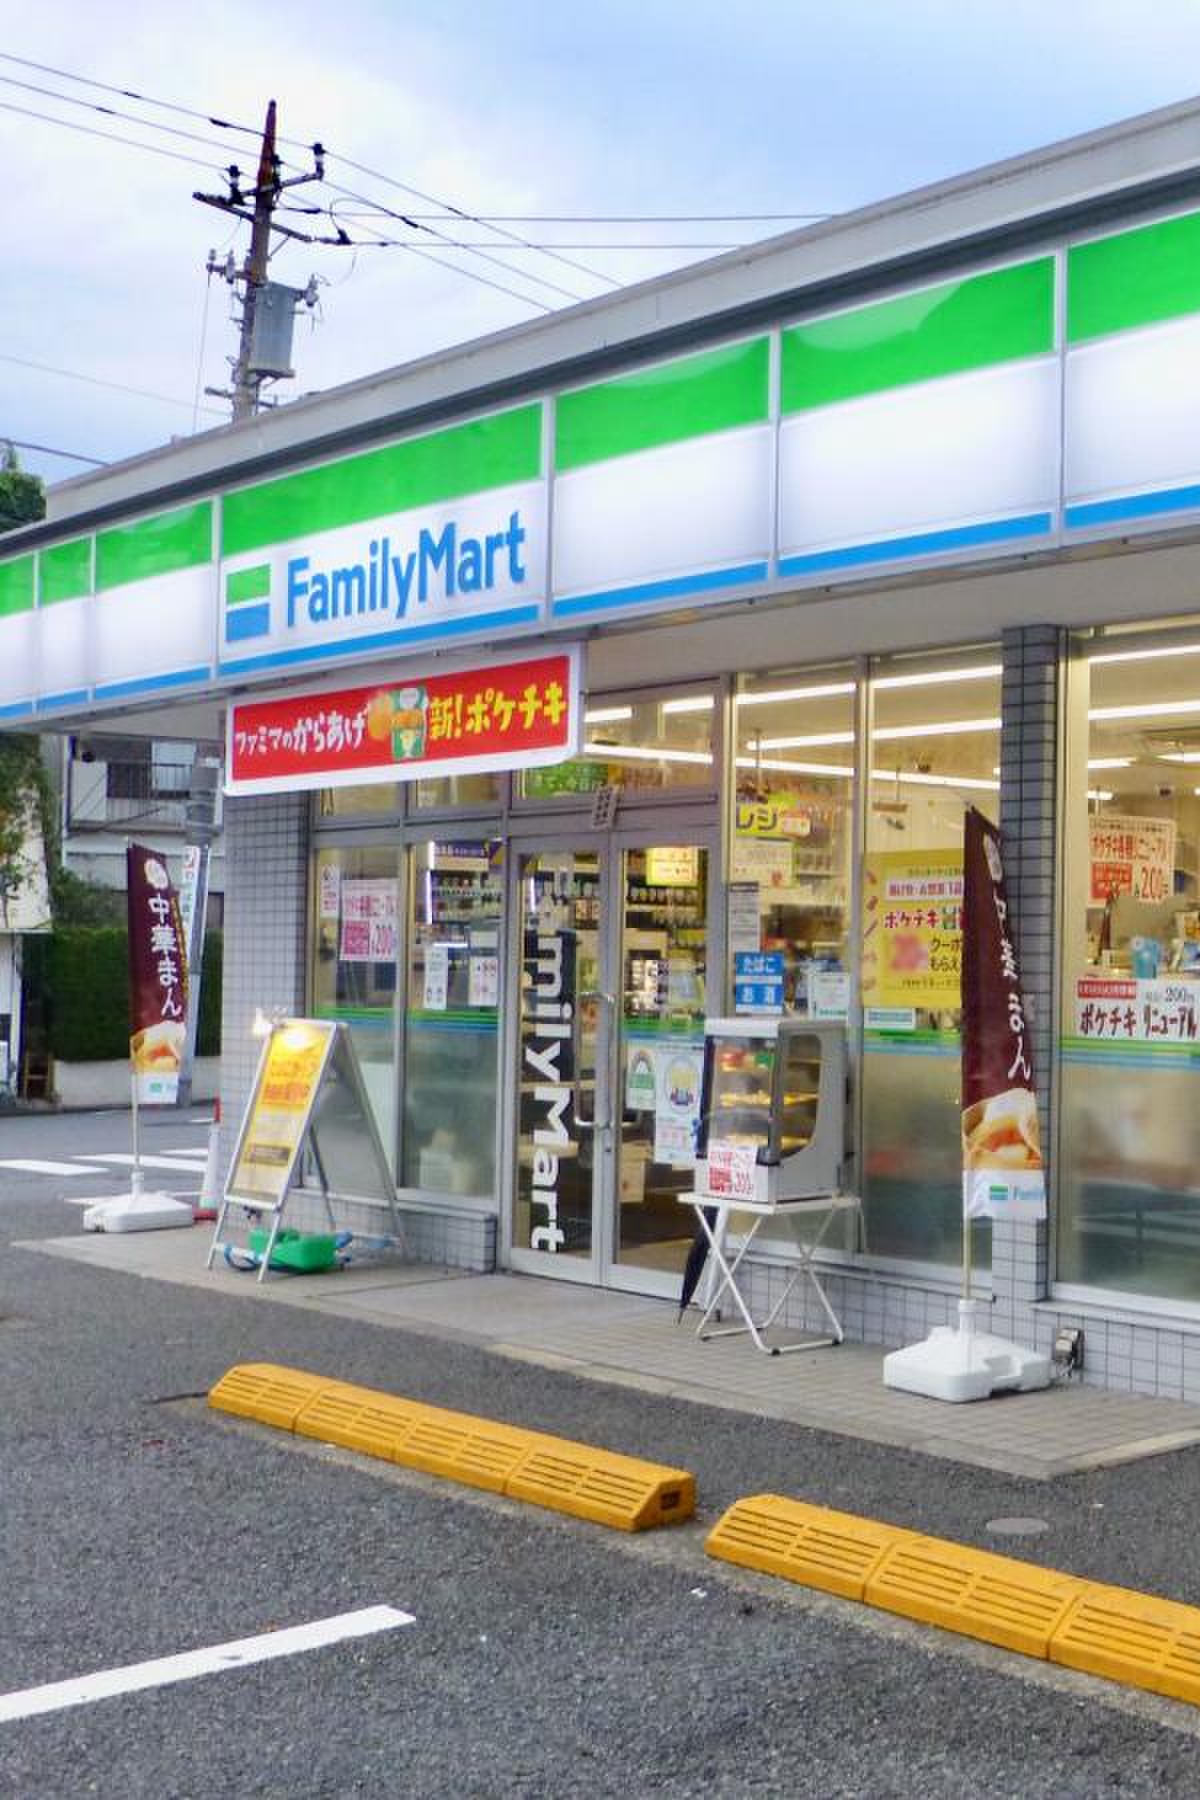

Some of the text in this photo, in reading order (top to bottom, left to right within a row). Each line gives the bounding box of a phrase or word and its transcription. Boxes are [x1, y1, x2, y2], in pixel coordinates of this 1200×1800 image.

[287, 510, 526, 628] FamilyMart
[147, 894, 183, 1017] 中華まん
[525, 870, 574, 1254] milyMart
